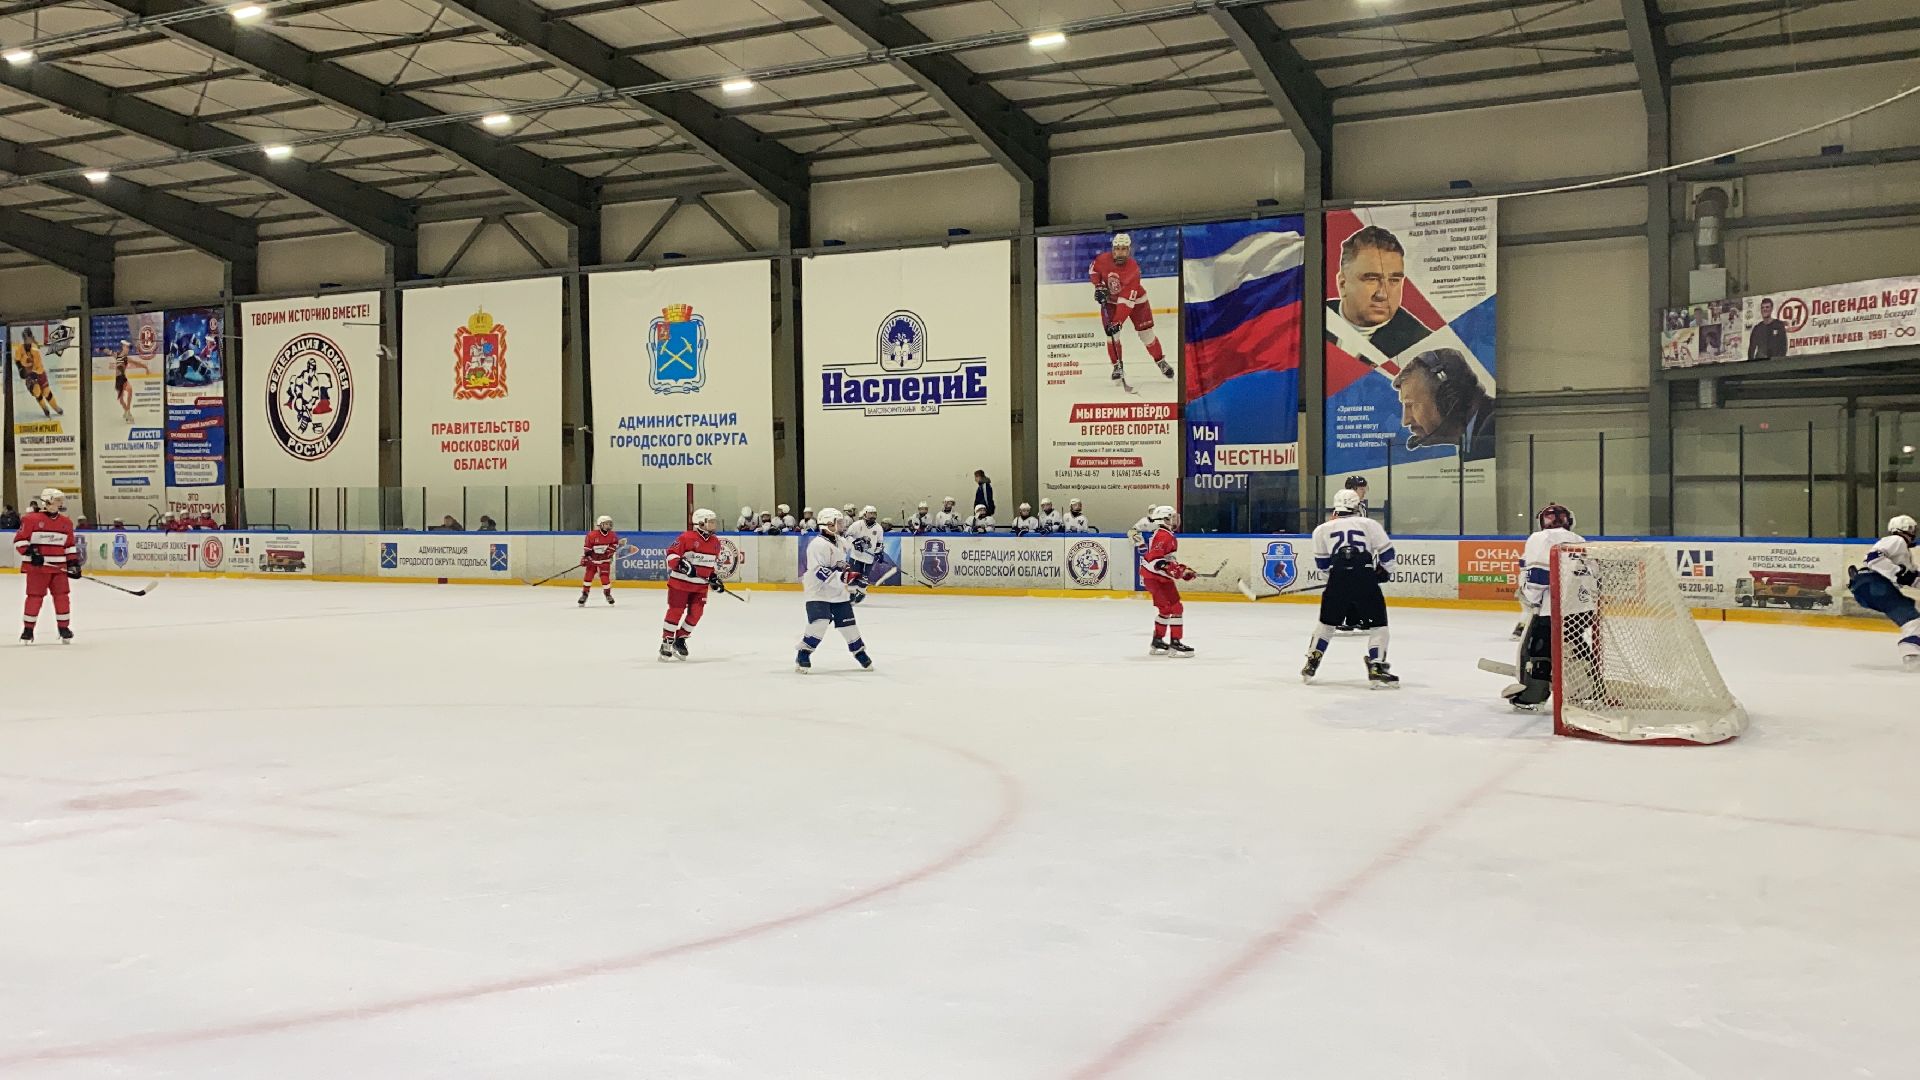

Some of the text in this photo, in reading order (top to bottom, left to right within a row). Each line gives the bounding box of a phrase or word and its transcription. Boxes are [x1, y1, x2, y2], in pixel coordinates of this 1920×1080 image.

[1812, 295, 1878, 316] Легенда
[252, 304, 370, 326] ТВОРИМ ИСТОРИЮ ВМЕСТЕ!
[1782, 305, 1802, 326] 97
[1789, 333, 1830, 348] ДМИТРИЙ
[321, 343, 350, 391] ХОККЕЯ
[868, 405, 916, 414] БЛАГОТВОРИТЕЛЬНЫЙ
[1076, 404, 1170, 420] МЫ ВЕРИМ ТВЁРДО
[432, 420, 530, 436] ПРАВИТЕЛЬСТВО
[618, 412, 737, 430] АДМИНИСТРАЦИЯ
[1082, 424, 1170, 436] В ГЕРОЕВ СПОРТА!
[1192, 426, 1218, 440] МЫ
[441, 436, 520, 452] МОСКОВСКОЙ
[610, 432, 748, 450] ГОРОДСКОГО ОКРУГА
[642, 452, 712, 468] ПОДОЛЬСК
[1194, 444, 1296, 466] ЗА ЧЕСТНЫЙ
[454, 458, 508, 470] ОБЛАСТИ
[1194, 474, 1248, 488] СПОРТ!
[136, 542, 187, 550] ФЕДЕРАЦИЯ ХОККЕ
[418, 546, 468, 555] АДМИНИСТРАЦИЯ
[132, 552, 188, 562] МОСКОВСКОЙ ОБЛАС
[961, 550, 1052, 562] ФЕДЕРАЦИЯ ХОККЕЯ
[1396, 554, 1436, 566] ОККЕЯ
[1476, 548, 1520, 560] ОКНА
[400, 558, 488, 567] ГОРОДСКОГО ОКРУГА ПОДОЛЬСК
[954, 564, 1060, 578] МОСКОВСКОЙ ОБЛАСТИ
[1678, 583, 1724, 592] 95 220-90-12
